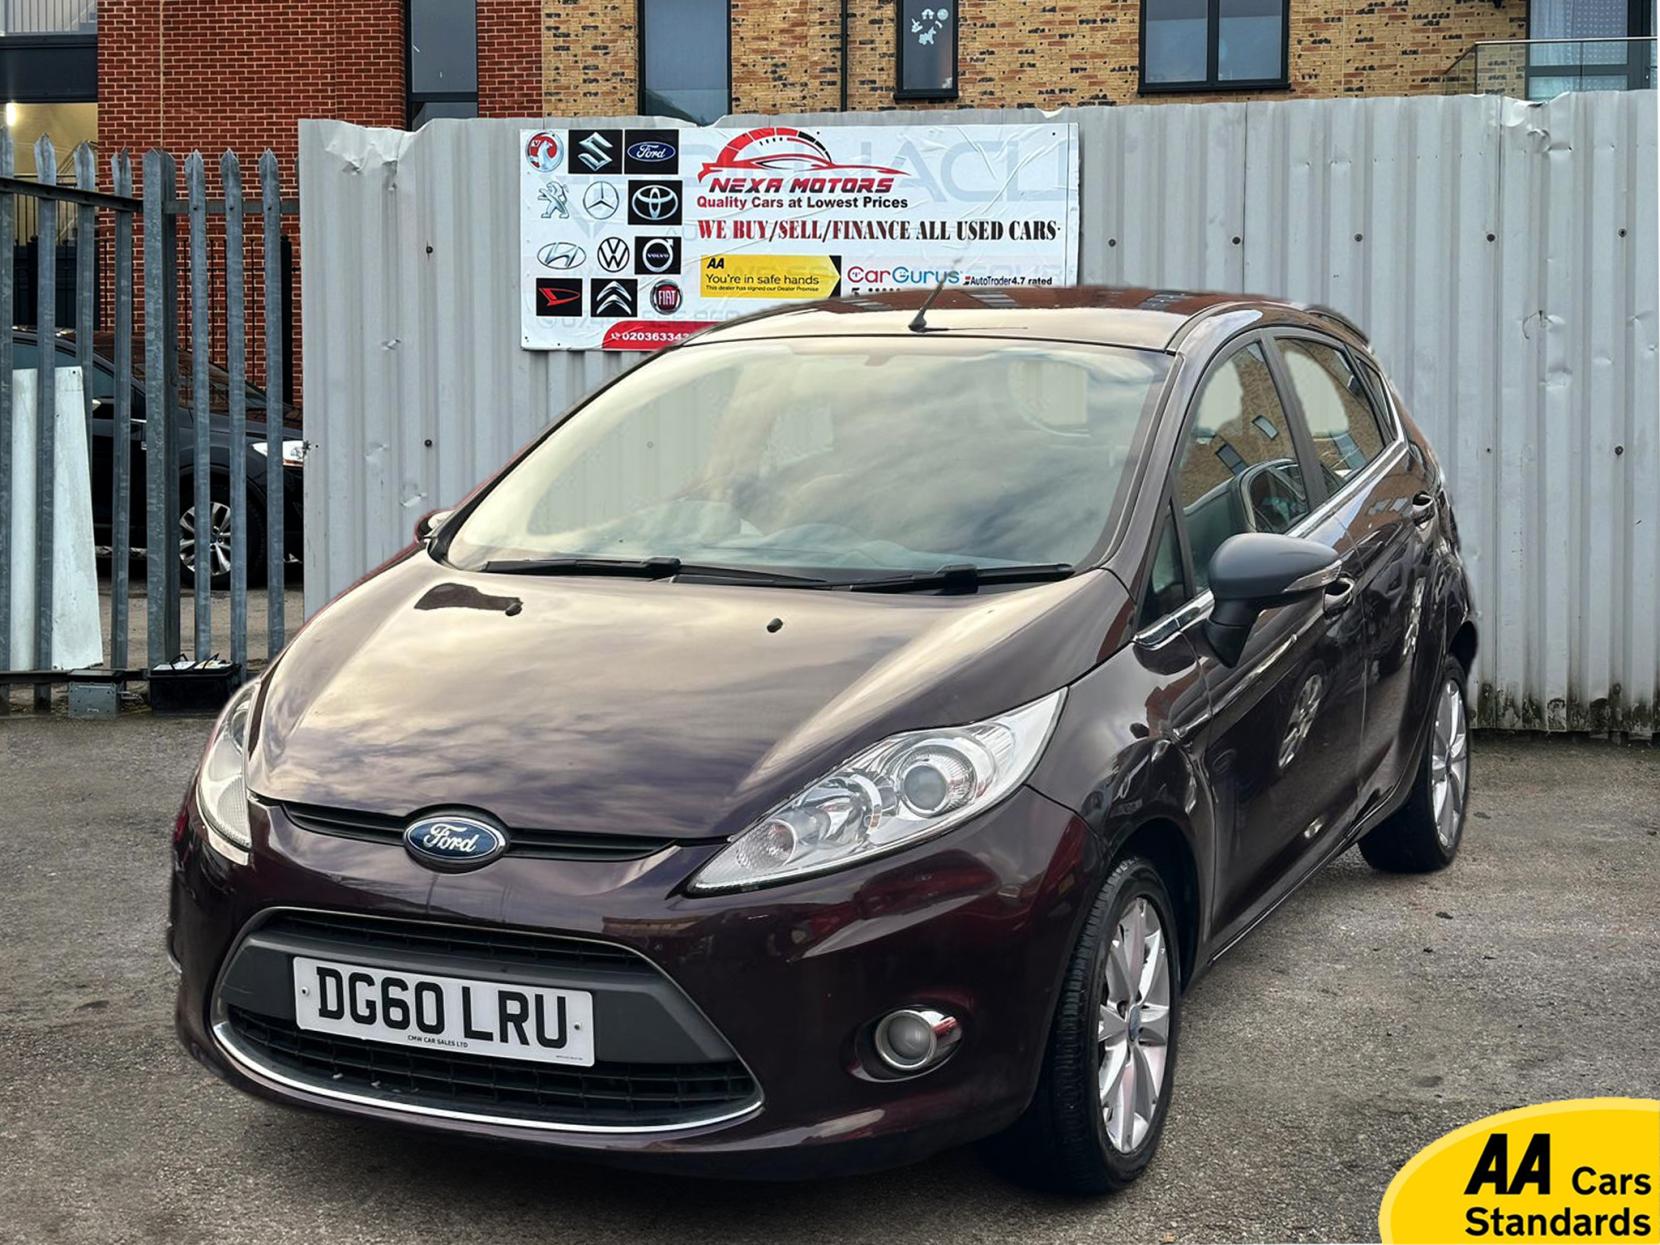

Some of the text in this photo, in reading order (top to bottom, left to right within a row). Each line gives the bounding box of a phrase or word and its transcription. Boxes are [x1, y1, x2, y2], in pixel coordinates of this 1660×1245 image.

[635, 143, 667, 159] Ford
[708, 177, 895, 194] NEXA MOTORS
[697, 196, 909, 210] Quality Cars at Lowest Prices
[696, 220, 727, 240] WE
[915, 220, 951, 240] ALL
[956, 220, 1004, 241] USED
[1008, 220, 1057, 241] CARS
[706, 257, 725, 269] AA
[705, 274, 820, 285] You're in safe hands
[847, 266, 960, 284] CarGurus
[1027, 277, 1053, 285] rated
[657, 290, 676, 305] FIAT
[423, 823, 480, 852] Ford
[315, 965, 568, 1049] DG60 LRU
[437, 1038, 456, 1047] SALES
